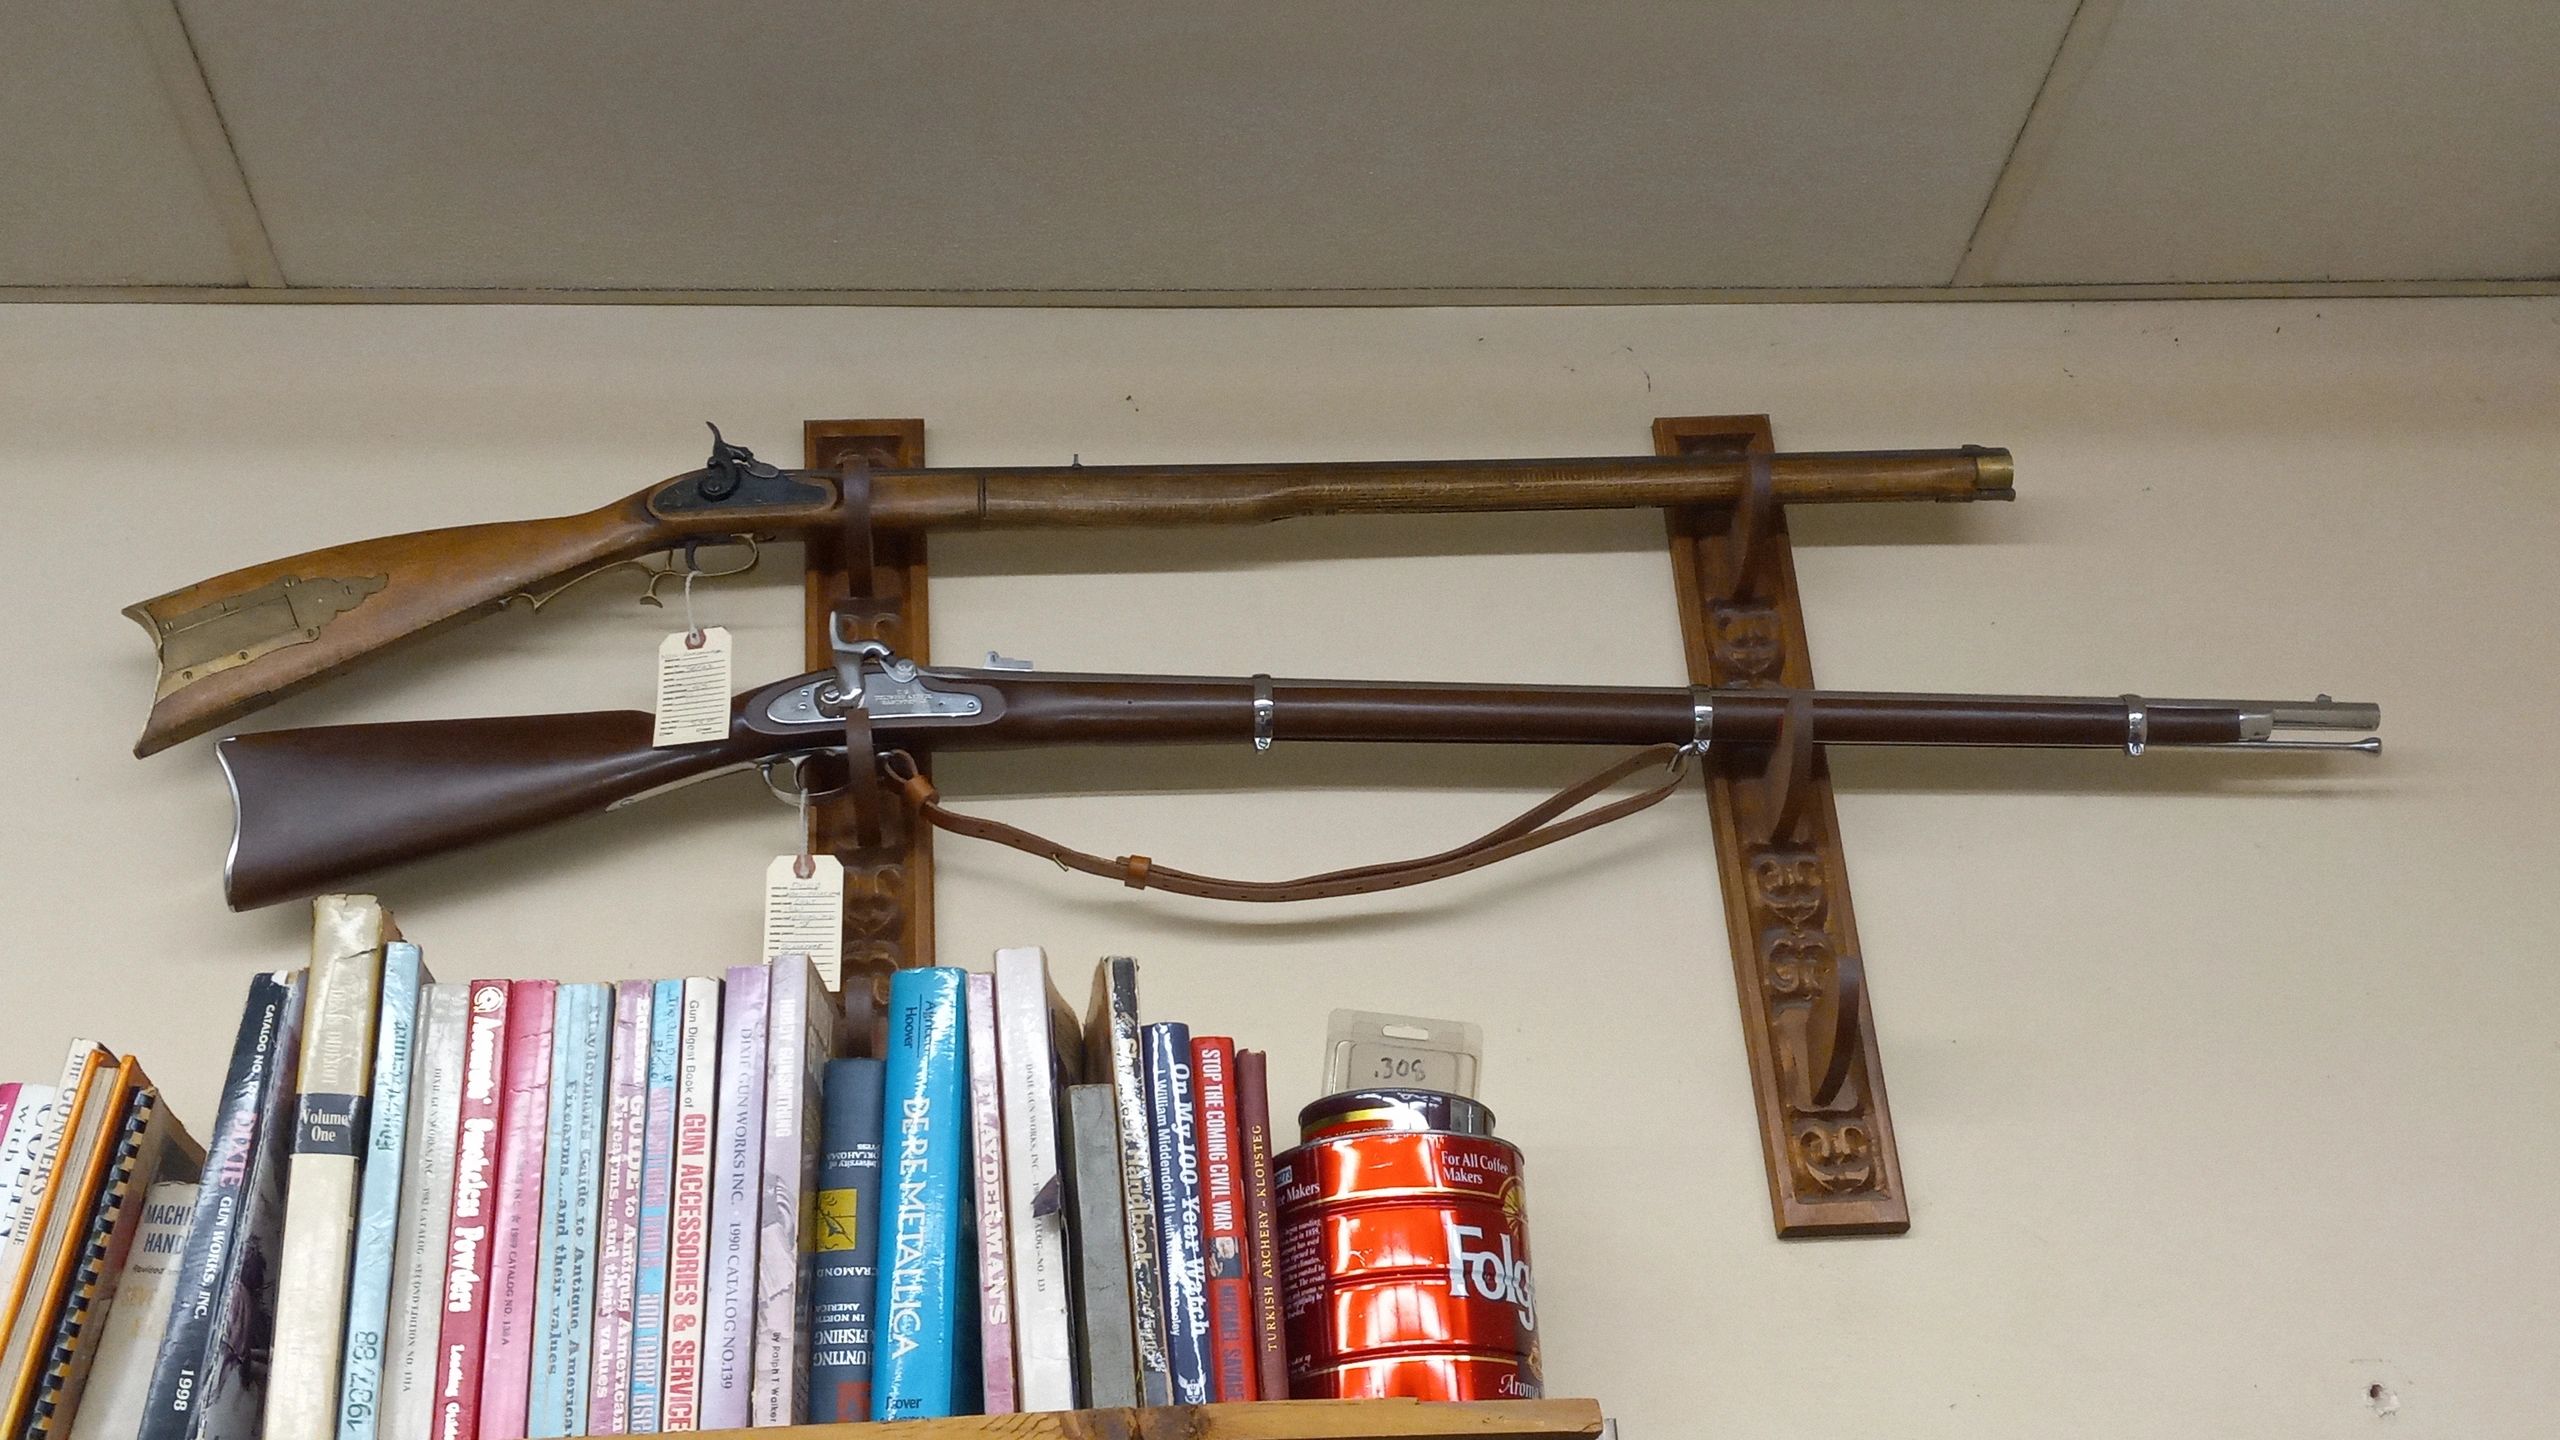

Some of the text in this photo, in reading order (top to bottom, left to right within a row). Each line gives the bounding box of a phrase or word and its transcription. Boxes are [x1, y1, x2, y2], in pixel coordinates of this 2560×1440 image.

[253, 1002, 277, 1054] CATALOG
[902, 1006, 917, 1048] Hoover
[66, 1051, 86, 1080] THE
[683, 999, 699, 1107] Gun Digest Book of
[1026, 1063, 1034, 1087] DIXIE
[1153, 1078, 1169, 1127] William
[1171, 1062, 1191, 1096] On
[302, 1108, 348, 1125] Volume
[311, 1125, 337, 1142] One
[730, 1027, 753, 1206] DIXIE GUN WORKS INC.
[1168, 1099, 1195, 1138] My
[1200, 1047, 1233, 1231] STOP THE COMING CIVIL WAR
[621, 1093, 645, 1191] GUIDE
[827, 1151, 880, 1161] OKLAHOMA
[1157, 1128, 1175, 1202] Middendorf
[1251, 1124, 1267, 1197] KLOPSTEG
[1441, 1150, 1509, 1175] For All Coffee
[1286, 1182, 1320, 1202] Makers
[1443, 1166, 1484, 1184] Makers
[12, 1204, 35, 1248] BIBLE
[191, 1108, 258, 1321] DIXIE GUN WORKS, INC.
[574, 1216, 586, 1236] to
[622, 1194, 637, 1218] to
[887, 1096, 930, 1361] DE RE METALLICA
[1124, 1148, 1154, 1265] Handbook
[1163, 1215, 1176, 1238] with
[727, 1222, 742, 1251] 1990
[1257, 1209, 1272, 1278] ARCHERY
[504, 1250, 517, 1297] CATALOG
[551, 1242, 568, 1297] their
[565, 1245, 586, 1329] Antique
[599, 1262, 618, 1318] their
[666, 1112, 707, 1431] GUN ACCESSORIES & SERVICE
[722, 1254, 741, 1332] CATALOG
[817, 1266, 878, 1278] CRAMOND
[1446, 1223, 1535, 1332] Folg
[503, 1299, 513, 1317] NO.
[815, 1303, 860, 1312] AMERICA
[852, 1314, 865, 1322] IN
[1185, 1255, 1210, 1336] Watch
[1262, 1285, 1278, 1351] TURKISH
[545, 1305, 563, 1376] values
[769, 1345, 781, 1374] Ralph
[814, 1328, 868, 1345] FISHING
[593, 1326, 613, 1398] values
[608, 1316, 633, 1433] American
[1220, 1348, 1246, 1401] SAVAGE
[170, 1367, 196, 1413] 1998
[769, 1387, 779, 1422] Walker
